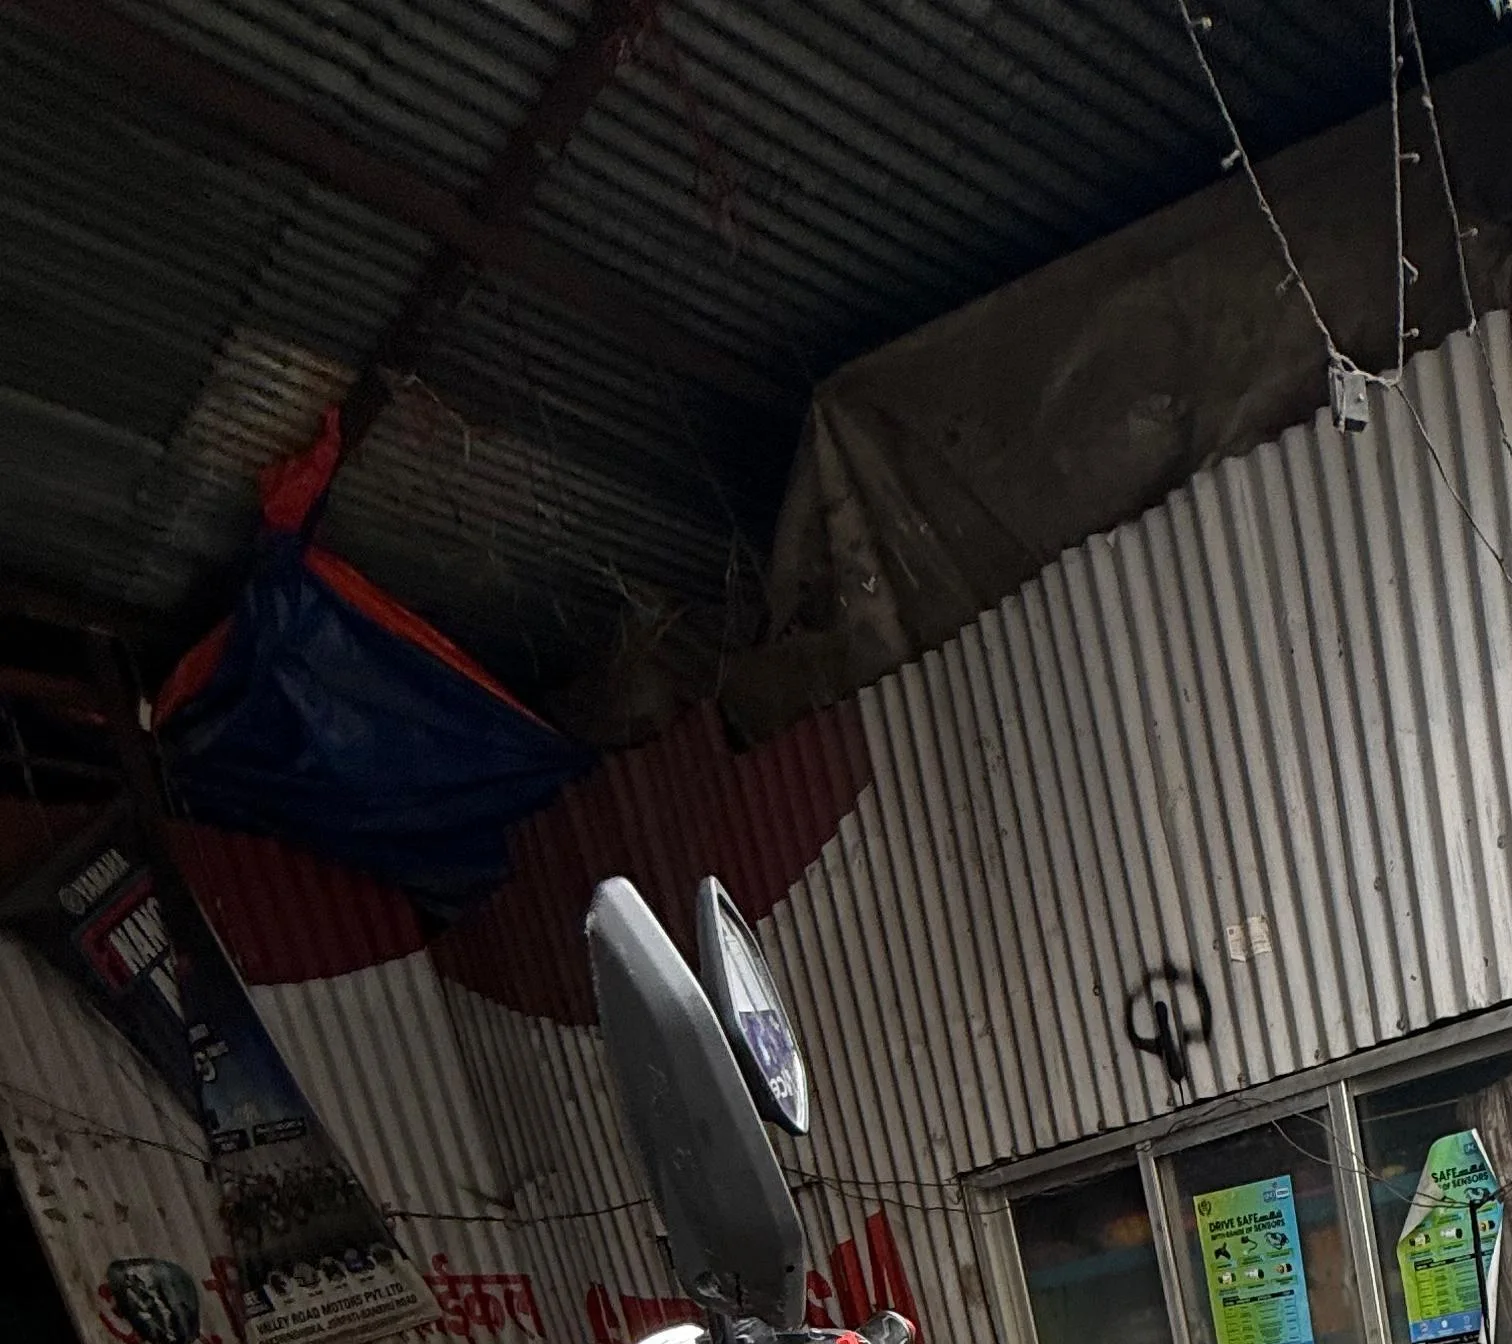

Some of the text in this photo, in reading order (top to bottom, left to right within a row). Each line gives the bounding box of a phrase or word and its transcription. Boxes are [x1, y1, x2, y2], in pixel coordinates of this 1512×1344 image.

[1431, 1166, 1458, 1183] SAFE
[1209, 1212, 1259, 1233] DRIVE SAFE
[256, 1312, 292, 1335] VALLEY
[292, 1305, 320, 1326] ROAD
[320, 1293, 364, 1316] MOTORS
